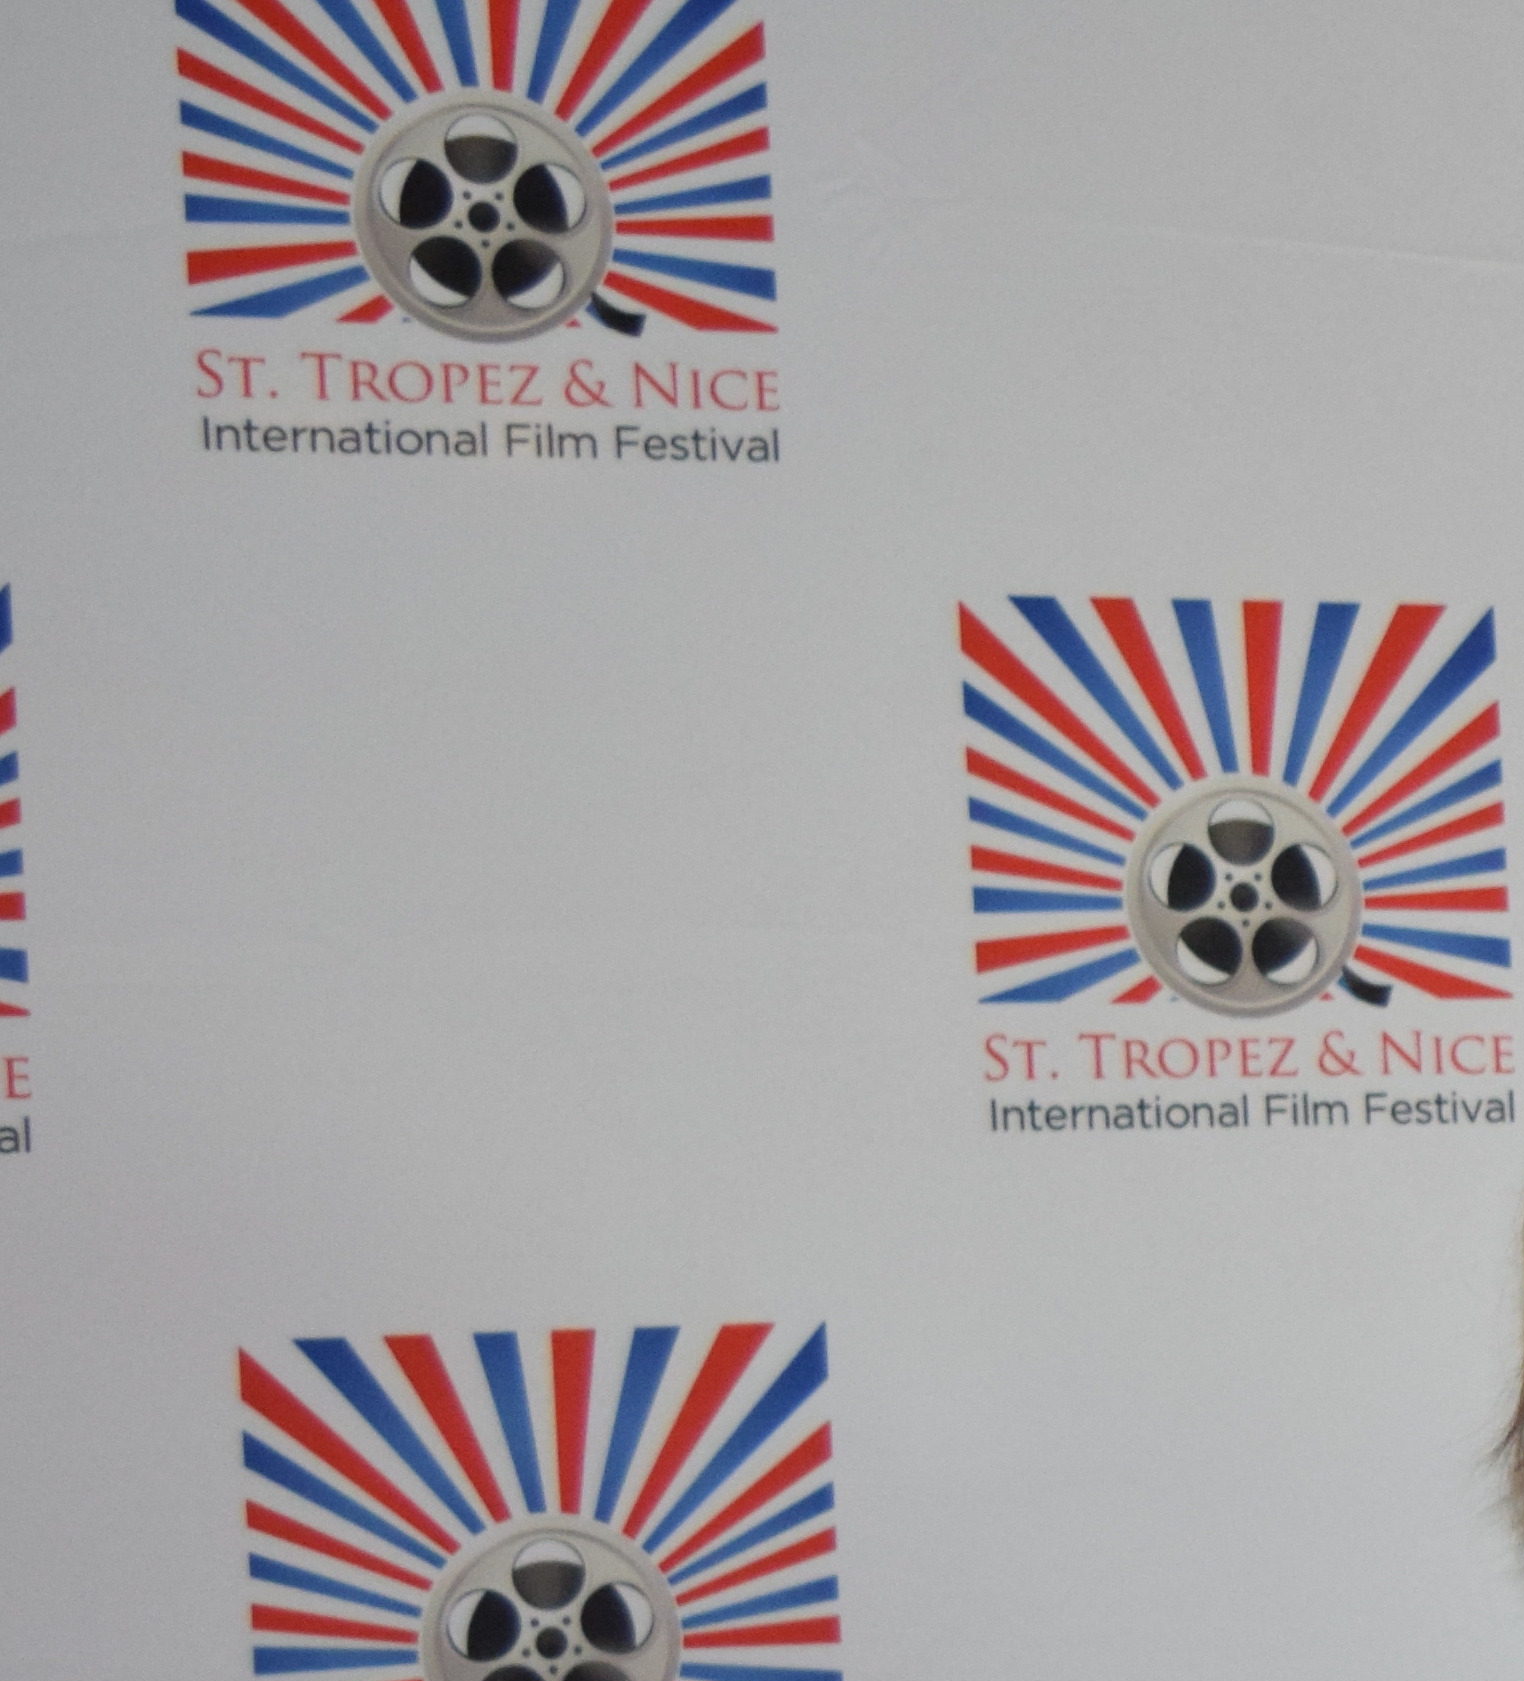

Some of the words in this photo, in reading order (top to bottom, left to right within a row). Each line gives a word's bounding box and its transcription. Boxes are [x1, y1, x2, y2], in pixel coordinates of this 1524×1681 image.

[195, 348, 279, 399] ST.
[299, 350, 544, 407] TROPEZ
[561, 358, 611, 409] &
[631, 362, 777, 412] NICE
[202, 416, 487, 457] International
[505, 423, 598, 459] Film
[615, 425, 779, 463] Festival
[982, 1032, 1062, 1082] ST.
[1077, 1031, 1299, 1080] TROPEZ
[1315, 1029, 1362, 1078] &
[1379, 1029, 1513, 1076] NICE
[990, 1094, 1249, 1132] International
[1264, 1092, 1349, 1126] Film
[1364, 1090, 1515, 1125] Festival
